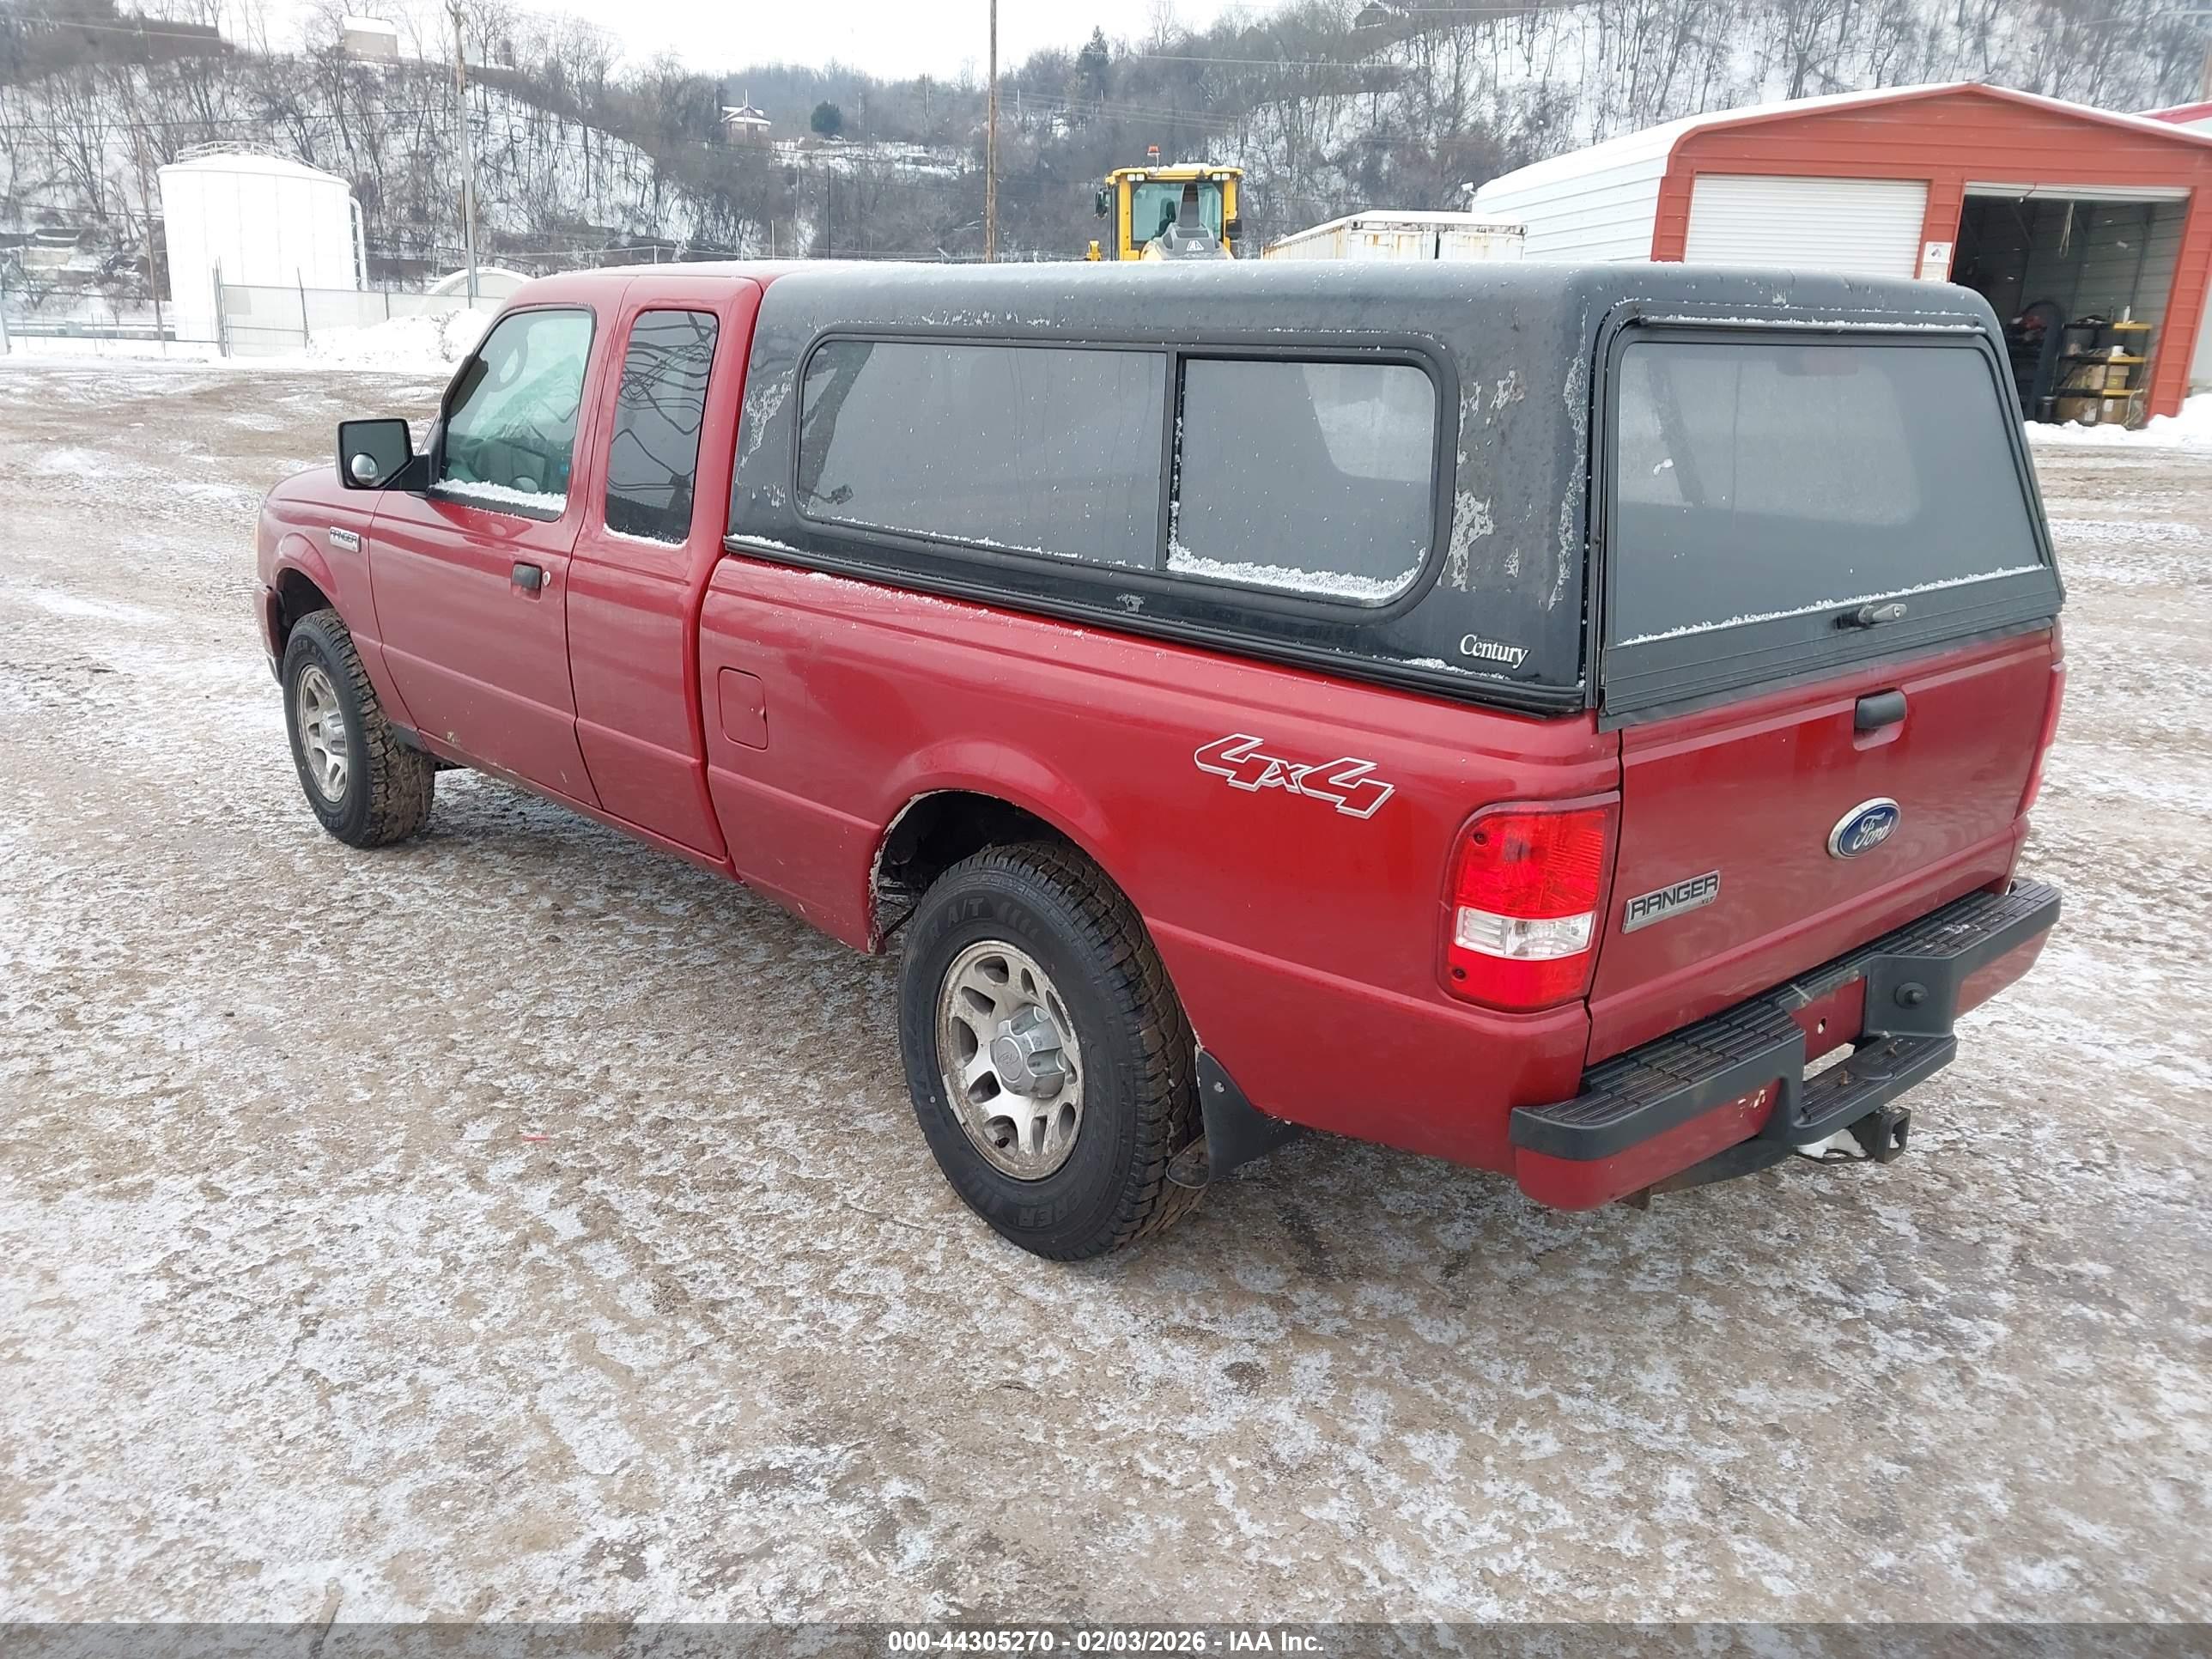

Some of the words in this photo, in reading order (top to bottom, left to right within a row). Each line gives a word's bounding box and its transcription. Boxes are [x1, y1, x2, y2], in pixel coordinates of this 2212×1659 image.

[330, 528, 357, 544] RANGER
[1459, 633, 1530, 670] Century
[1194, 732, 1396, 820] 4x4
[1852, 811, 1893, 850] Ford
[1630, 873, 1719, 921] RANGER
